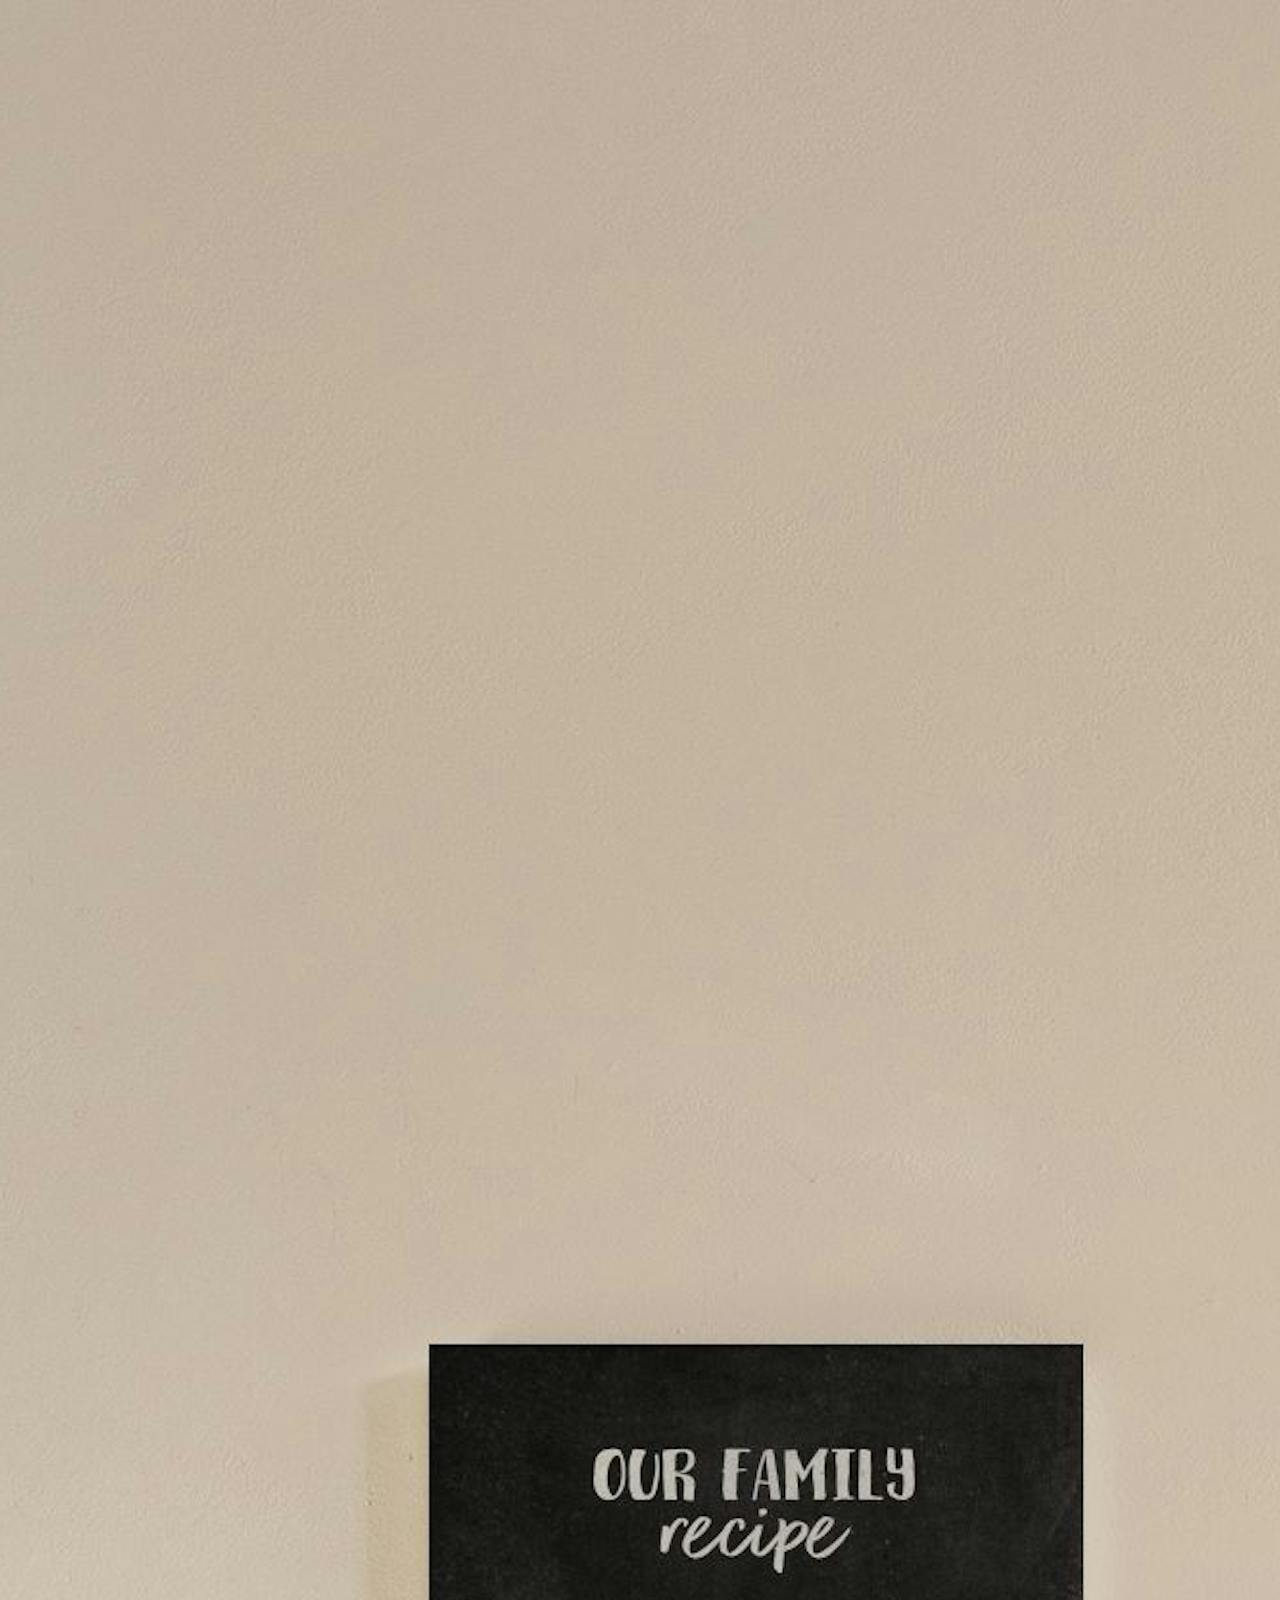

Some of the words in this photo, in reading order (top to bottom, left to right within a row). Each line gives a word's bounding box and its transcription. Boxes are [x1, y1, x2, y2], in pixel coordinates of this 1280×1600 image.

[592, 1448, 696, 1502] OUR
[721, 1446, 916, 1501] FAMILY
[659, 1507, 851, 1574] recipe
